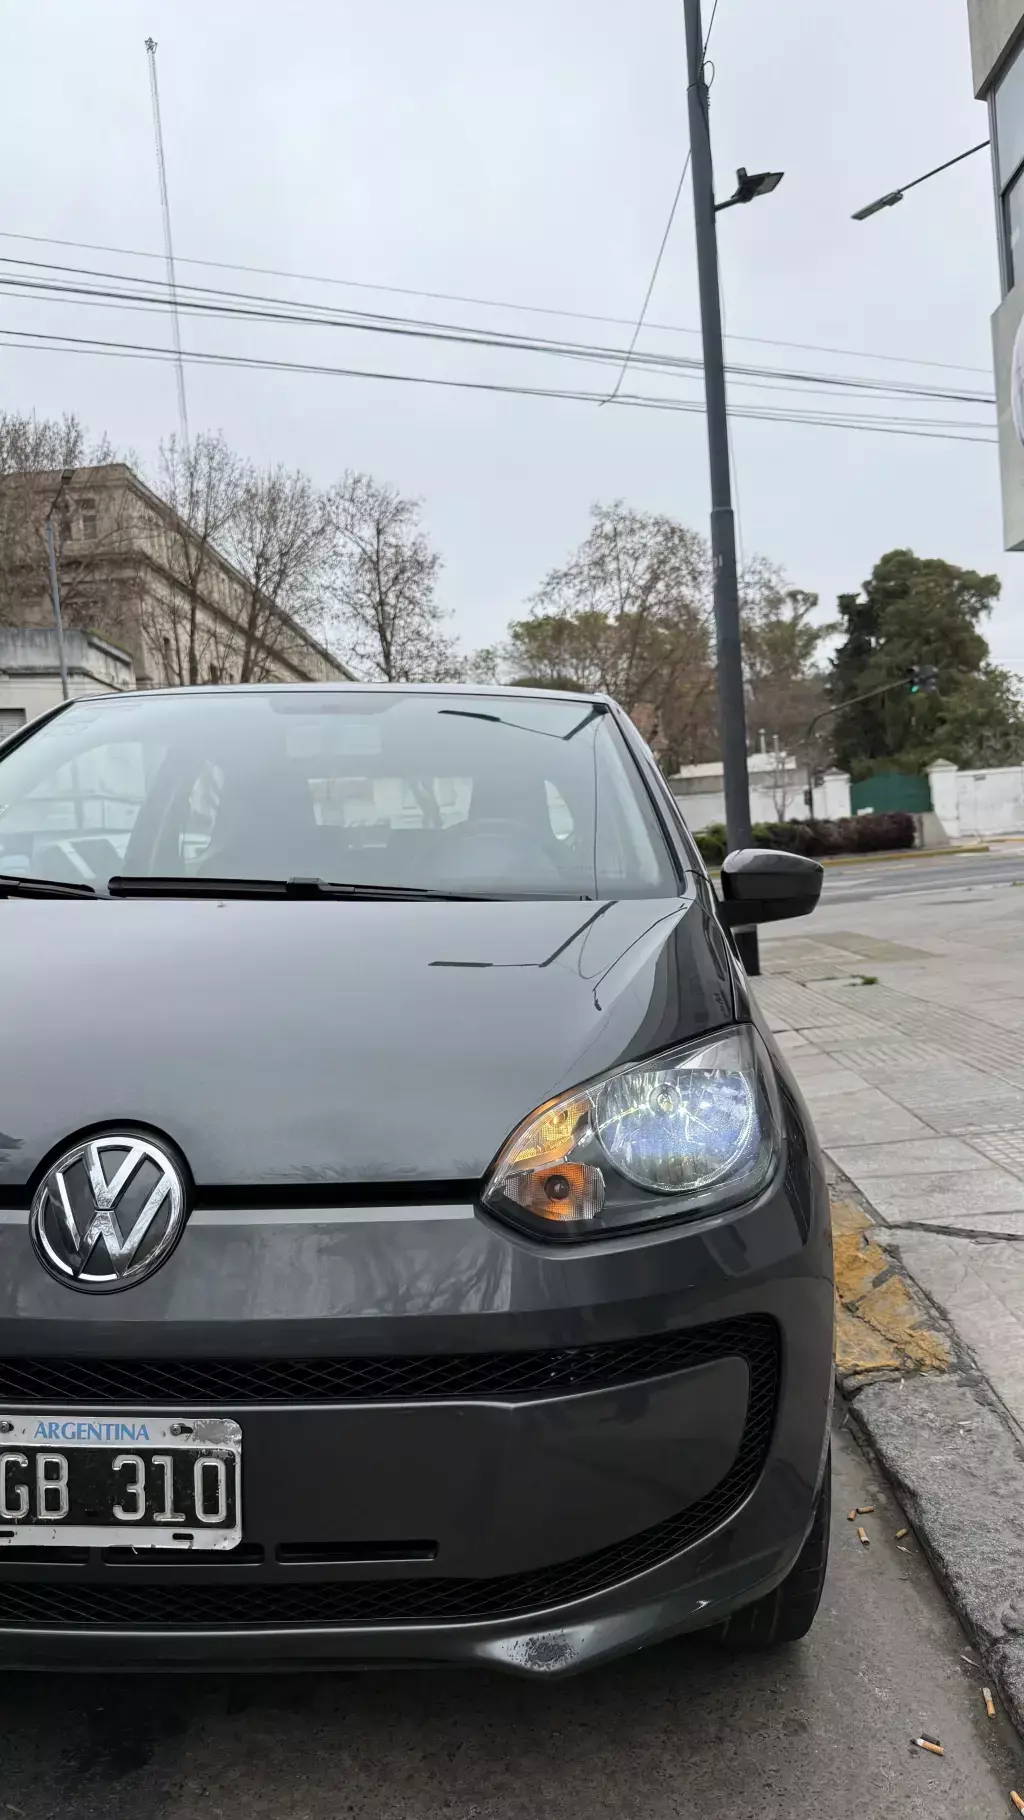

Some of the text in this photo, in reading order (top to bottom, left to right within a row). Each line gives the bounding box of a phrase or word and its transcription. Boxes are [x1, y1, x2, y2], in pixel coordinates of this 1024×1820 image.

[38, 1137, 181, 1284] VW
[33, 1421, 150, 1441] ARGENTINA
[112, 1454, 227, 1522] 310
